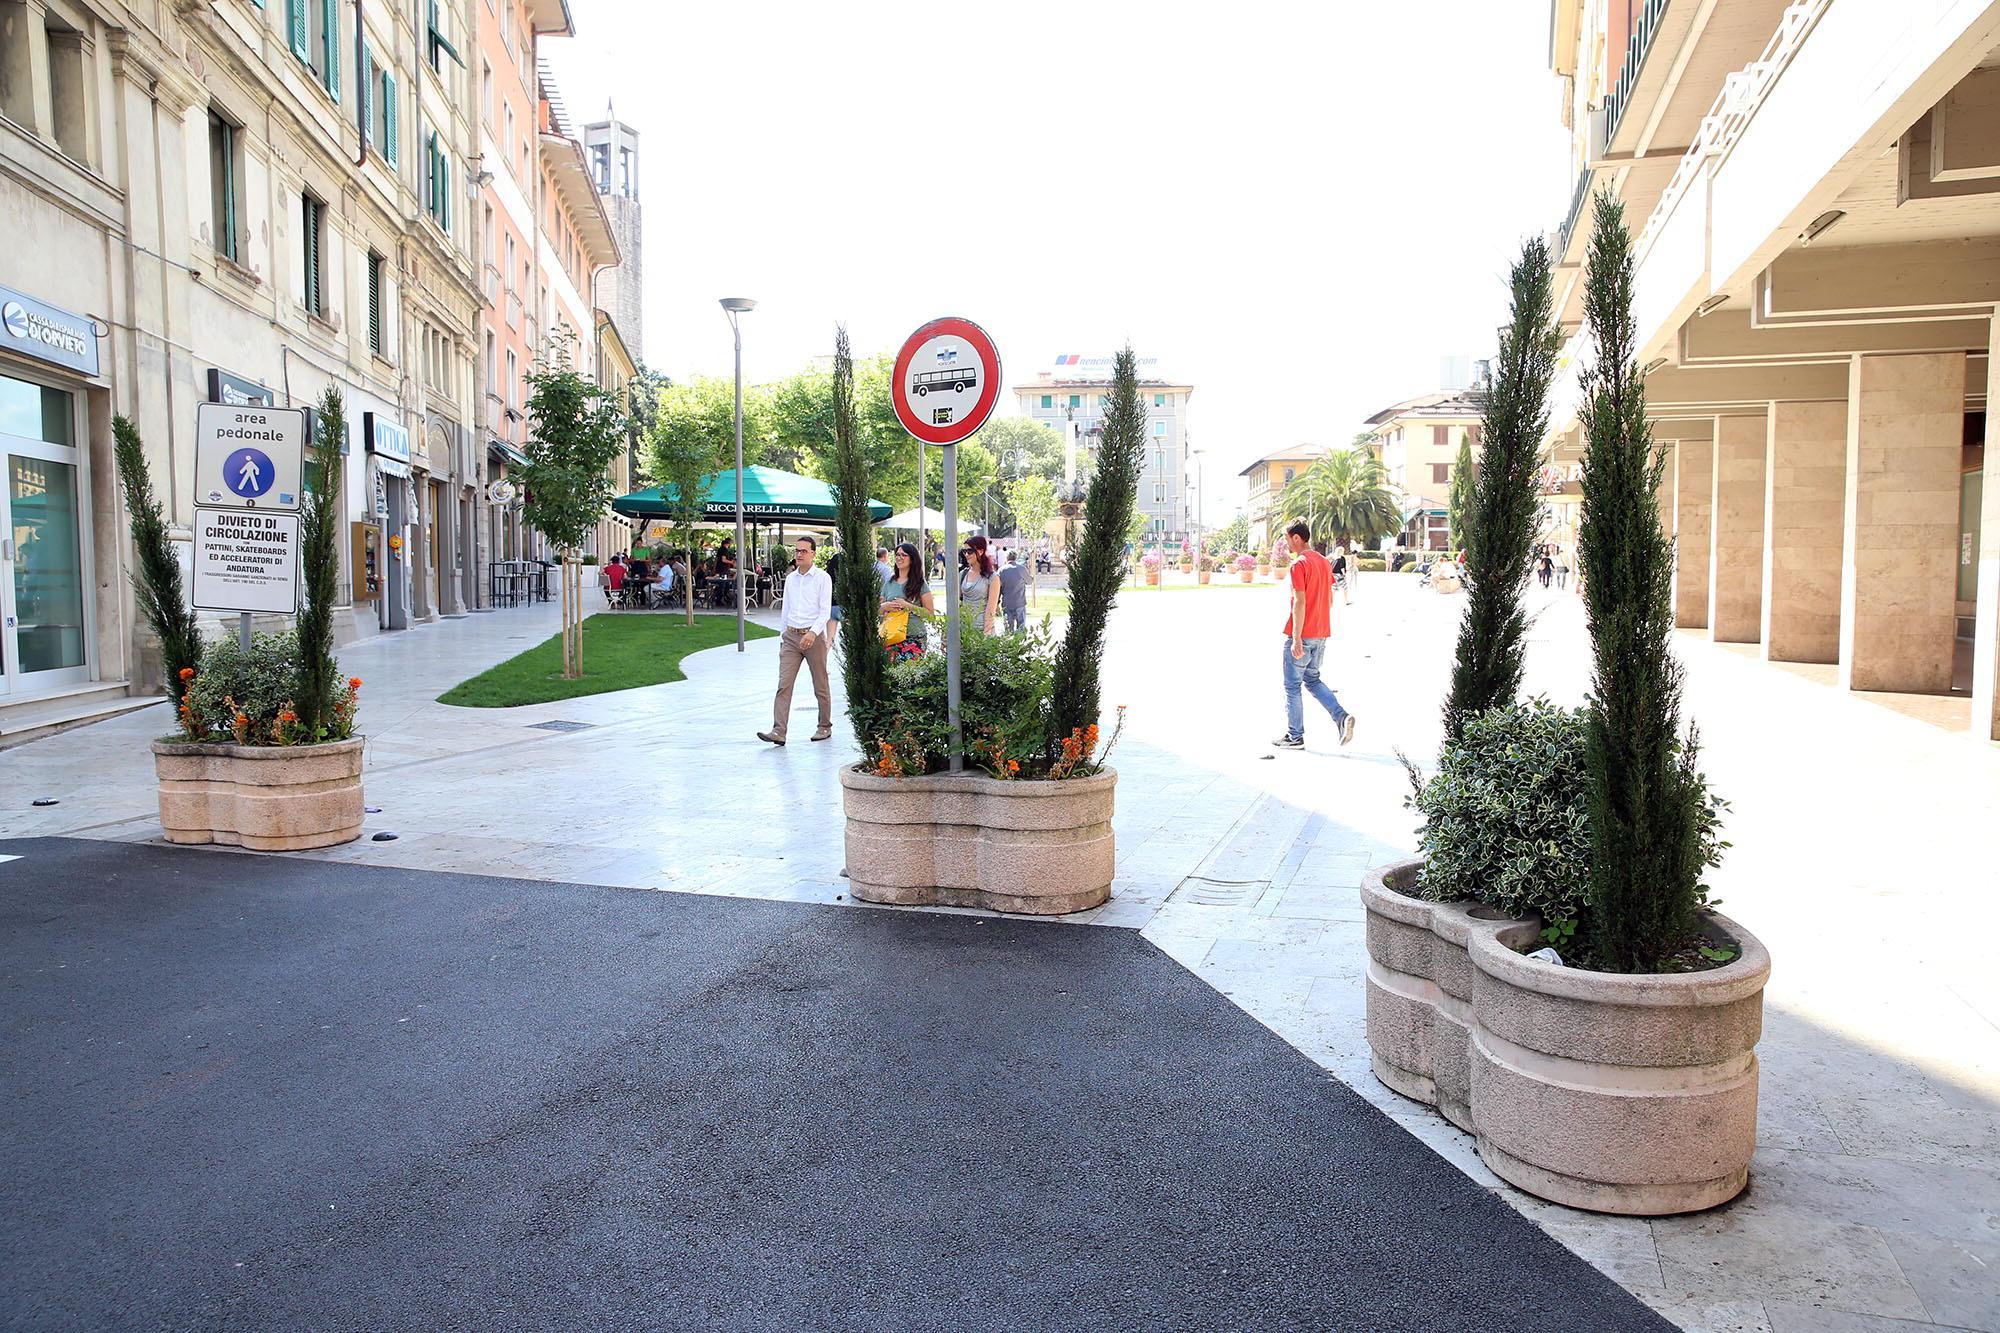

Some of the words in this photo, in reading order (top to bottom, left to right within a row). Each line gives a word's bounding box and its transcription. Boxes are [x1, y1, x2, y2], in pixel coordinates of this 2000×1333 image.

[28, 322, 42, 342] DI
[41, 326, 87, 355] ORVIETO
[235, 413, 267, 424] area
[216, 427, 284, 442] pedonale
[376, 422, 408, 456] OTTICA
[218, 515, 261, 528] DIVIETO
[265, 518, 277, 529] DI
[206, 527, 288, 542] CIRCOLAZIONE
[205, 543, 234, 553] PATTINI,
[236, 545, 287, 555] SKATEBOARDS
[209, 553, 219, 561] ED
[220, 554, 273, 565] ACCELERATORI
[226, 564, 265, 574] ANDATURA
